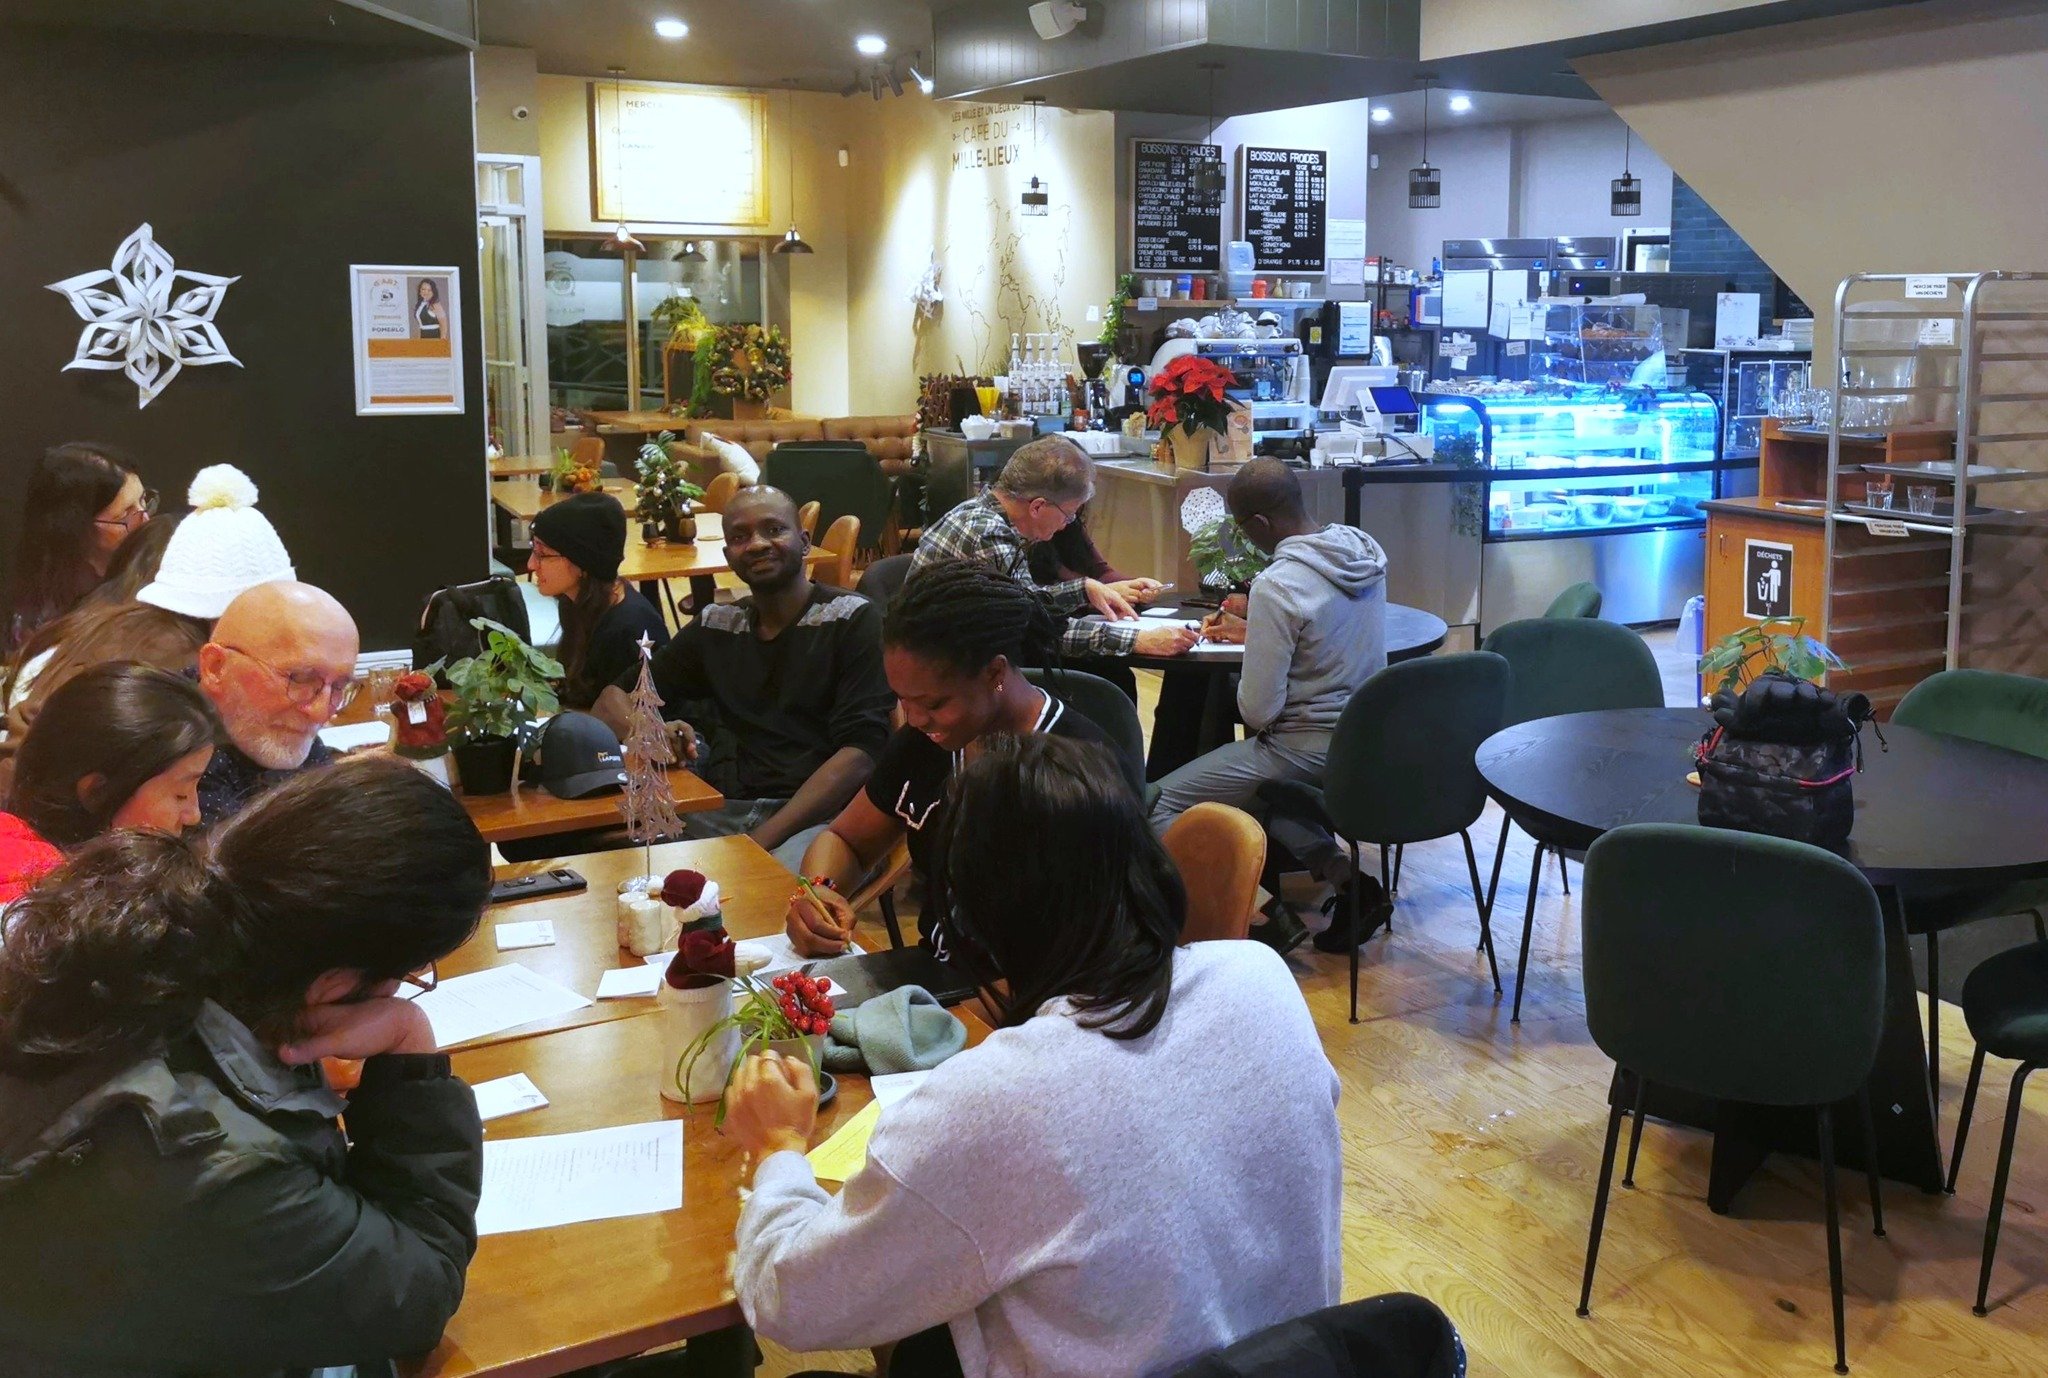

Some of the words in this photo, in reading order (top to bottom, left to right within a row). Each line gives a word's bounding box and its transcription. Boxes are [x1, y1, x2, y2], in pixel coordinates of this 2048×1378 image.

[952, 111, 961, 122] LES
[977, 107, 984, 117] ET
[986, 105, 994, 115] UN
[964, 120, 989, 144] CAFÉ
[994, 122, 1008, 139] DU
[952, 144, 1020, 170] MILLE-LIEUX
[1142, 143, 1178, 154] BOISSONS
[1181, 146, 1216, 156] CHAUDES
[1250, 151, 1287, 162] BOISSONS
[1290, 153, 1320, 164] FROIDES
[1757, 550, 1783, 560] DÉCHETS
